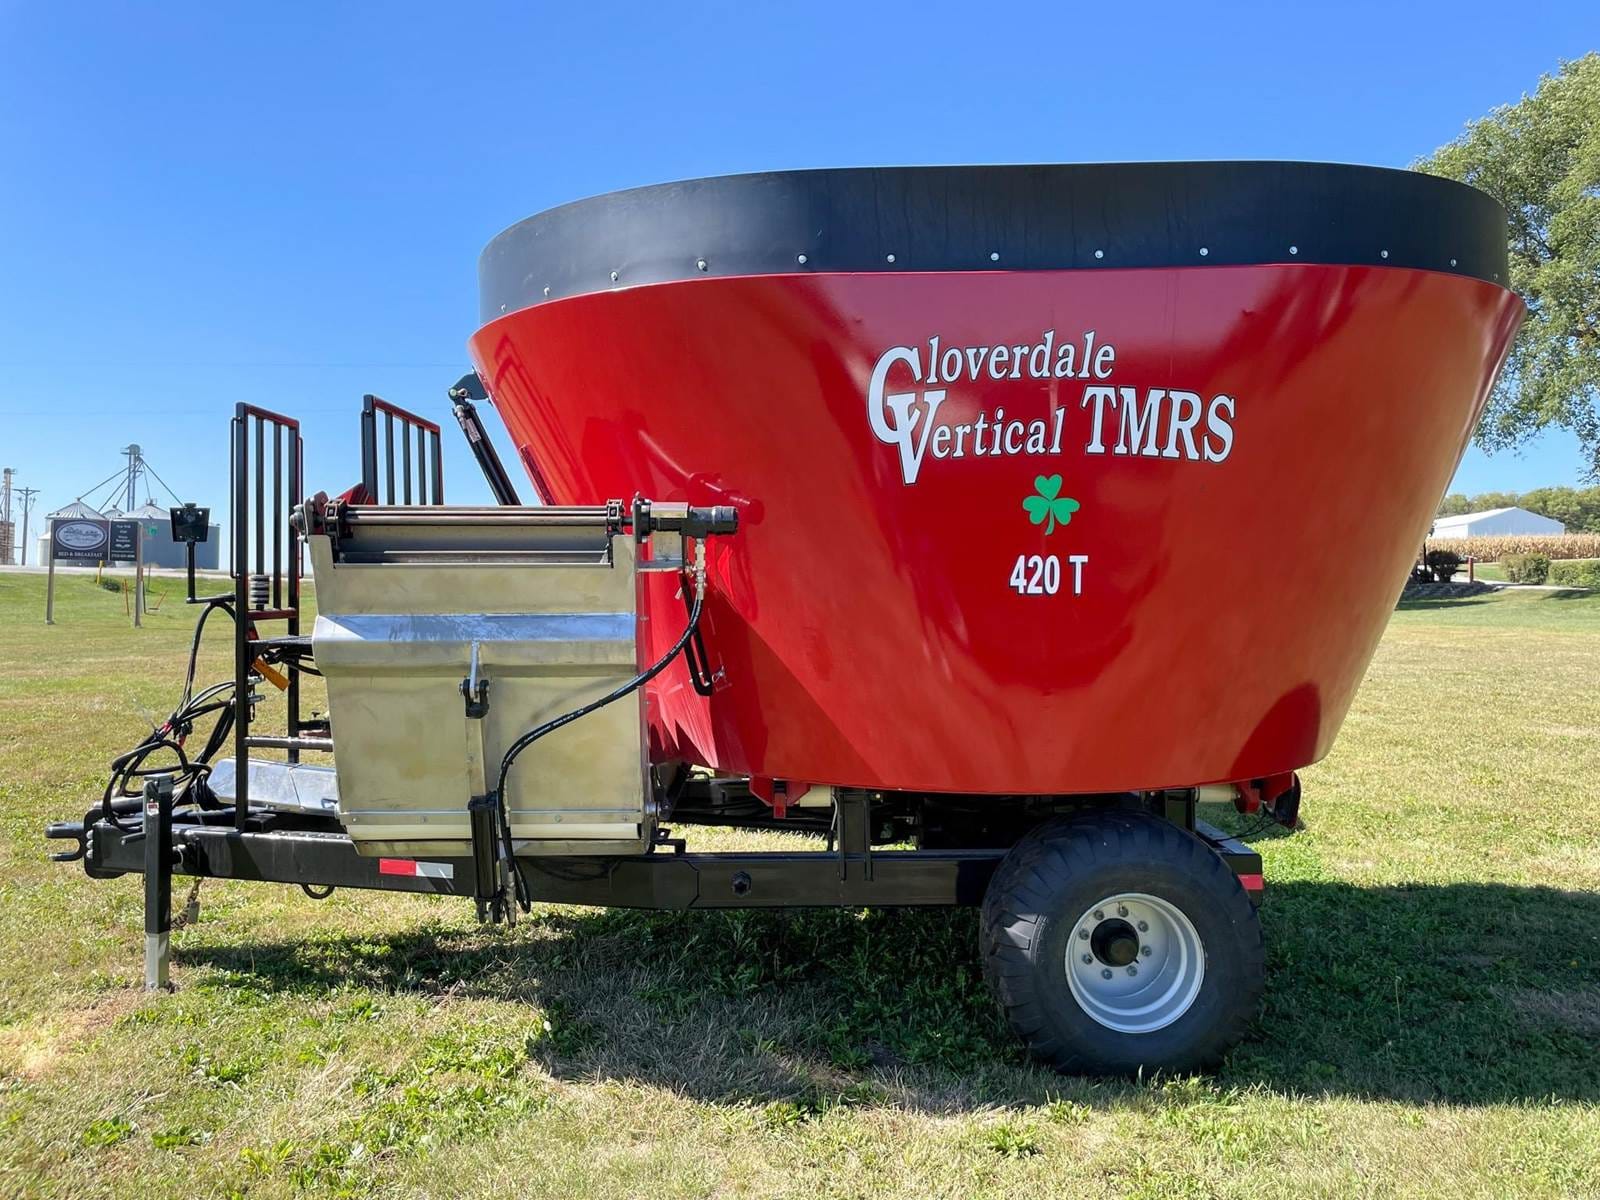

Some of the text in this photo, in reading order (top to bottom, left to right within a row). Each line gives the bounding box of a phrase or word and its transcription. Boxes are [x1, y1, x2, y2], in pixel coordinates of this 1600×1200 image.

[867, 329, 1116, 445] Cloverdale
[886, 385, 1236, 485] Vertical TMRS
[1009, 554, 1089, 595] 420 T
